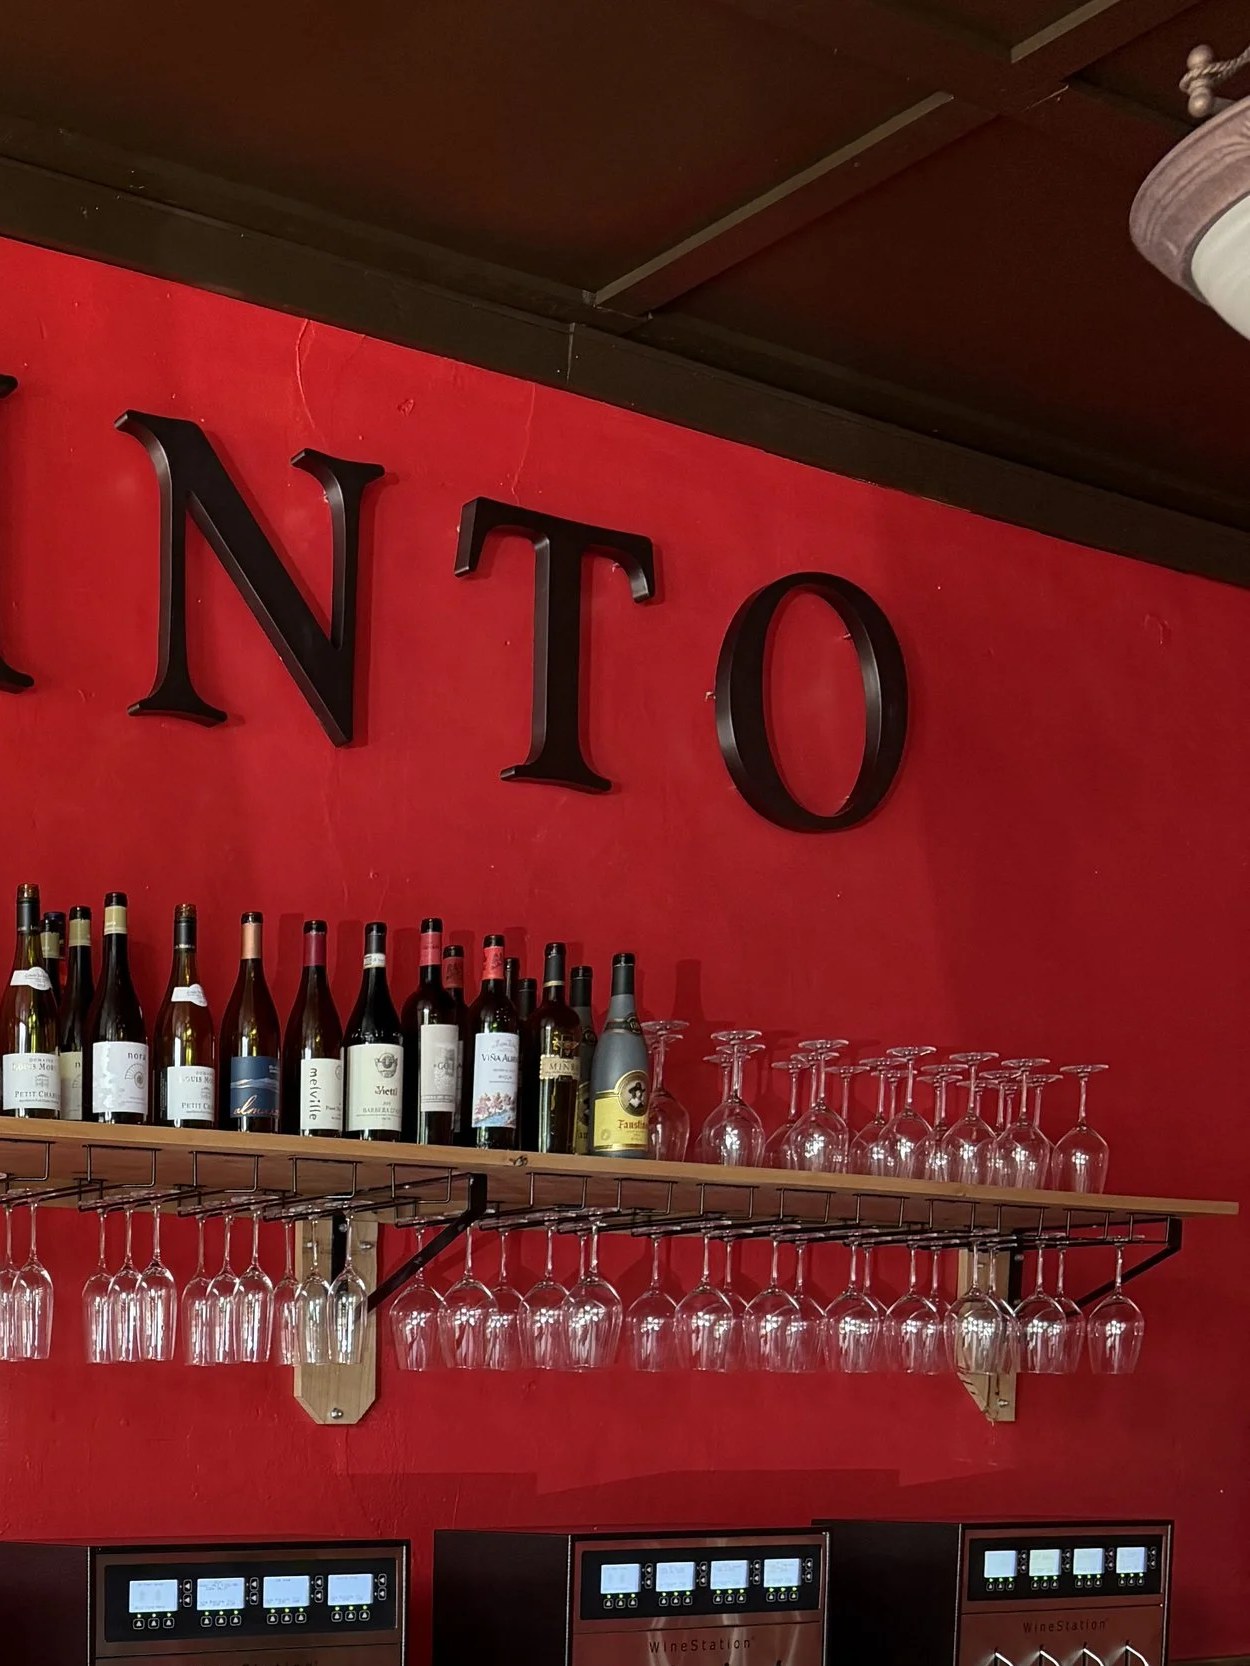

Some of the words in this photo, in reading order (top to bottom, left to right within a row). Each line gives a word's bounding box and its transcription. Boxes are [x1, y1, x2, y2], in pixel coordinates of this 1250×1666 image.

[481, 1052, 501, 1062] VIÑA
[14, 1090, 37, 1098] PETIT
[309, 1067, 322, 1121] melville
[1022, 1618, 1107, 1635] WineStation
[649, 1637, 751, 1654] WineStation
